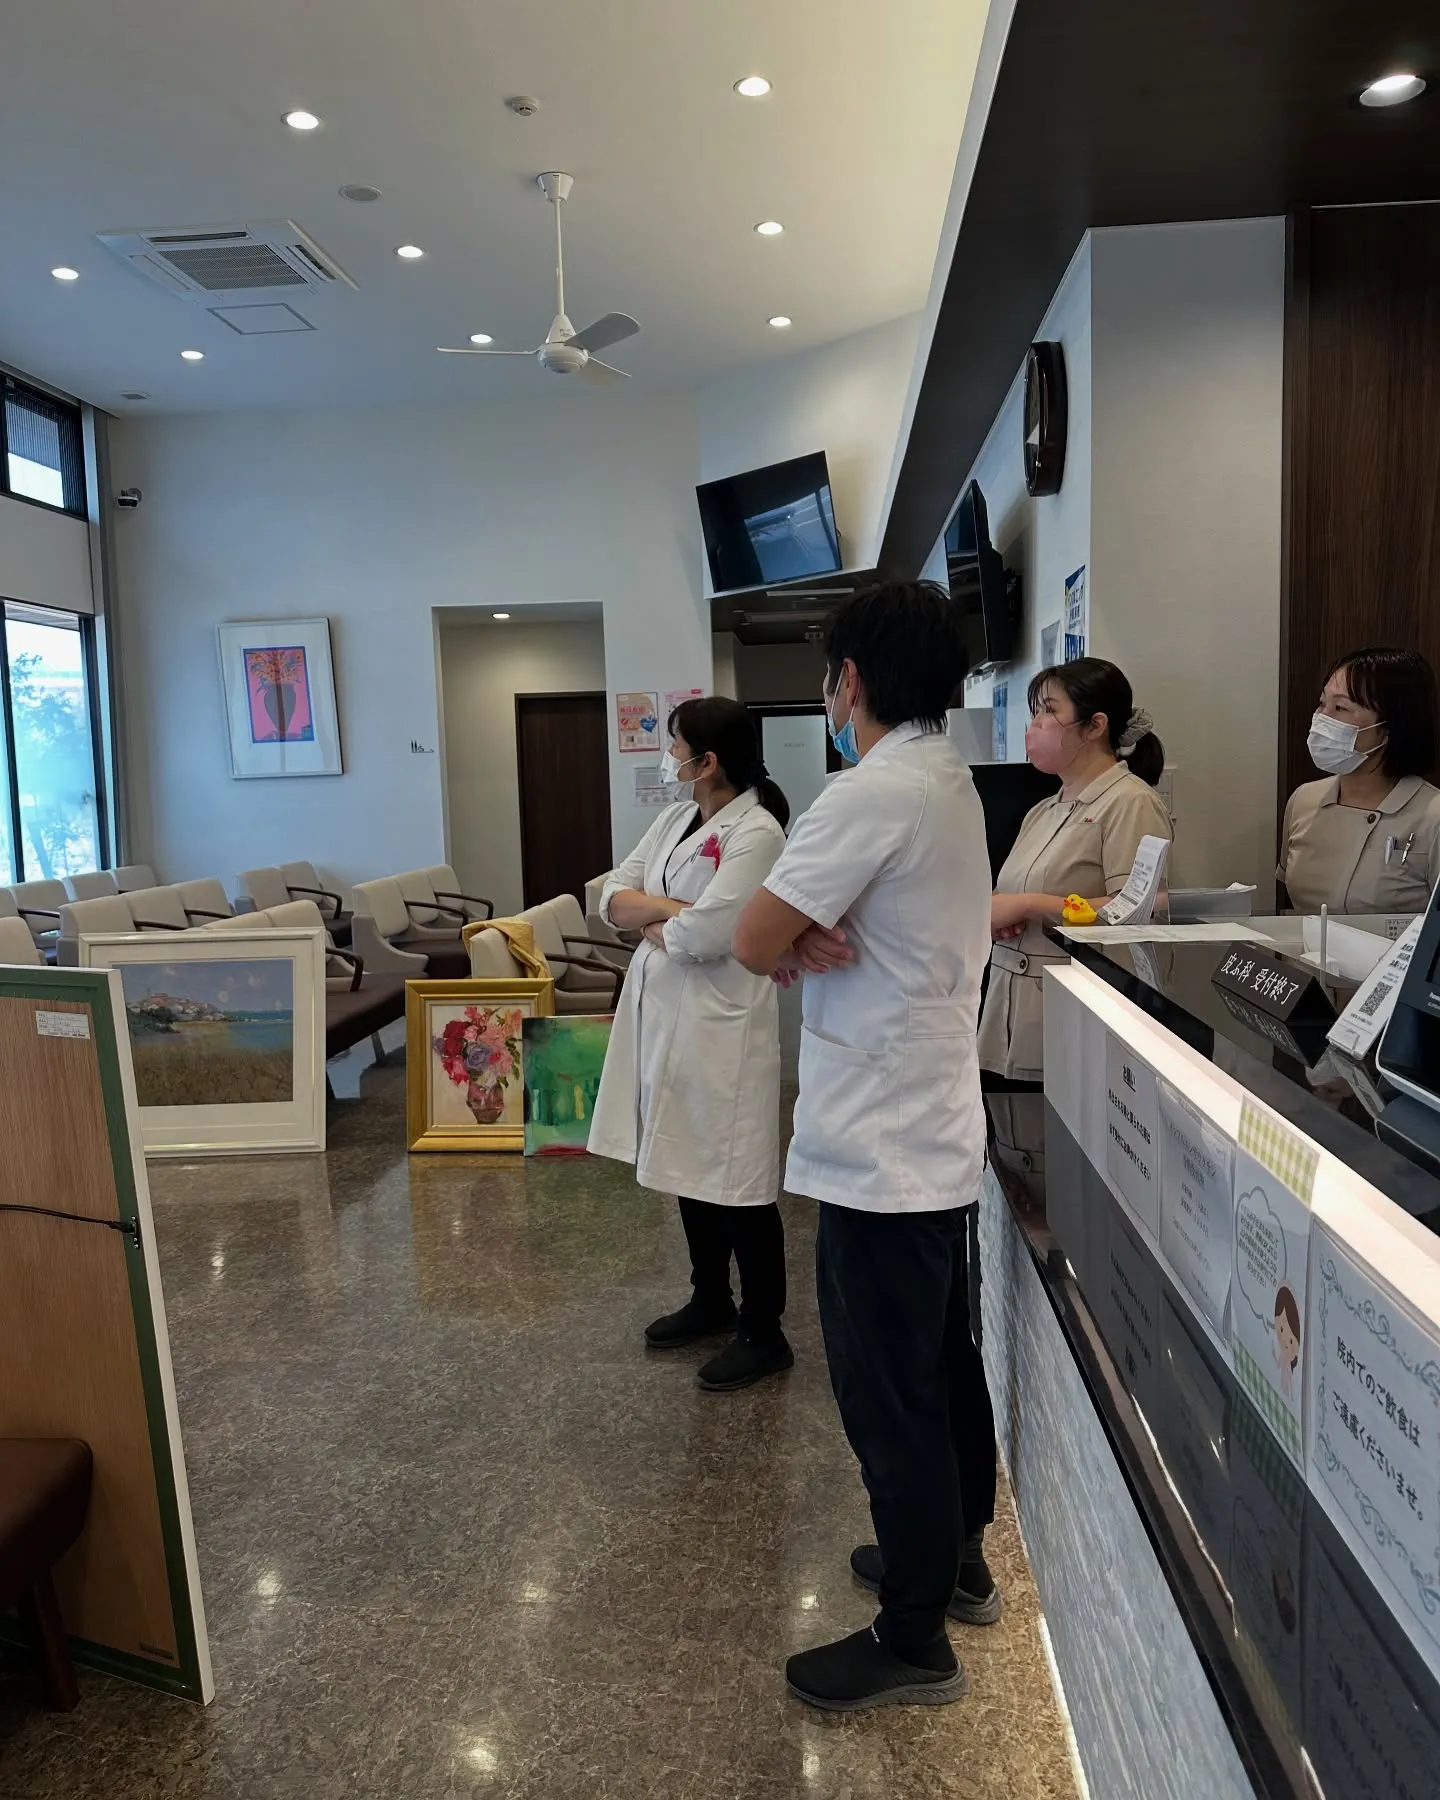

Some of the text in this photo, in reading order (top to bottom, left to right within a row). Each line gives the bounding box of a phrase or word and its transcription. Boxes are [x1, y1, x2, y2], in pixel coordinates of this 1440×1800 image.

[1220, 952, 1299, 1005] 皮ふ科 受付終了
[1336, 1335, 1420, 1448] 院内でのご飲食は
[1332, 1389, 1424, 1521] ご遠慮くださいませ。
